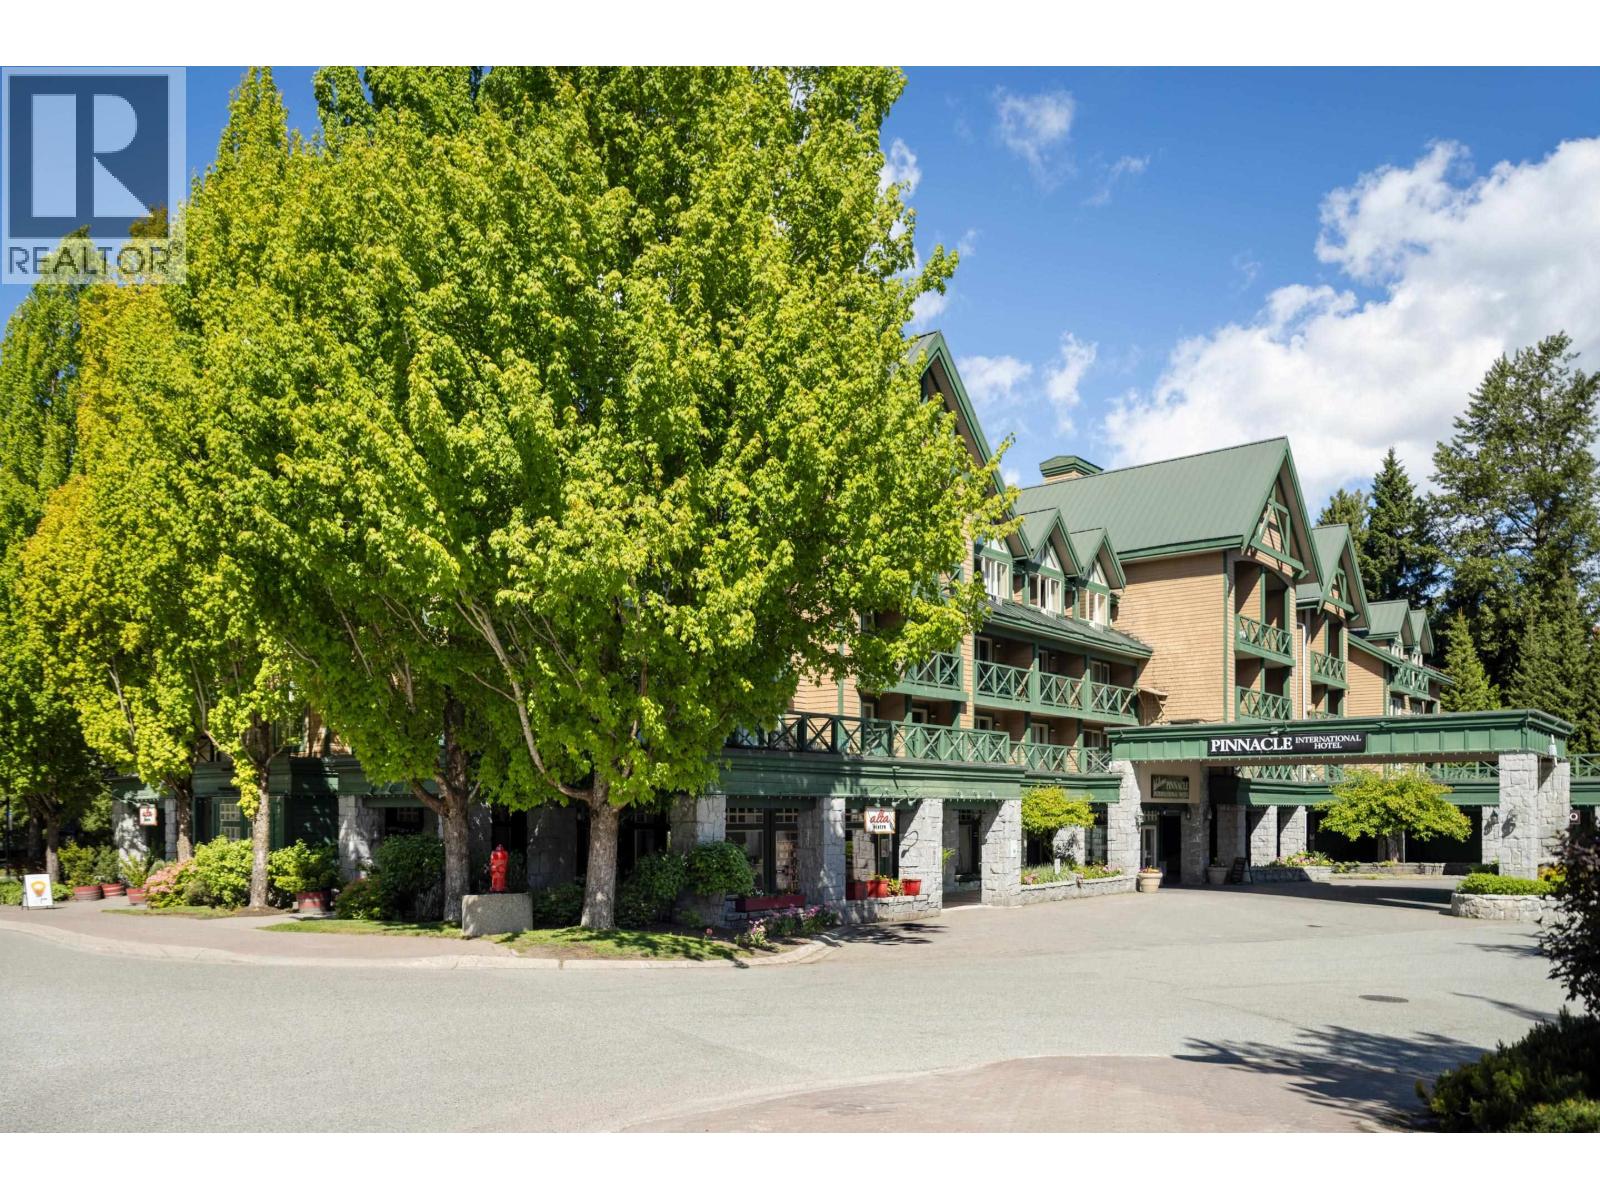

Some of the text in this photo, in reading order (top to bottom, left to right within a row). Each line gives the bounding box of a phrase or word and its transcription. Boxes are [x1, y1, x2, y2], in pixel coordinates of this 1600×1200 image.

[1210, 734, 1362, 753] PINNACLE INTERNATIONAL
[1314, 741, 1343, 750] HOTEL
